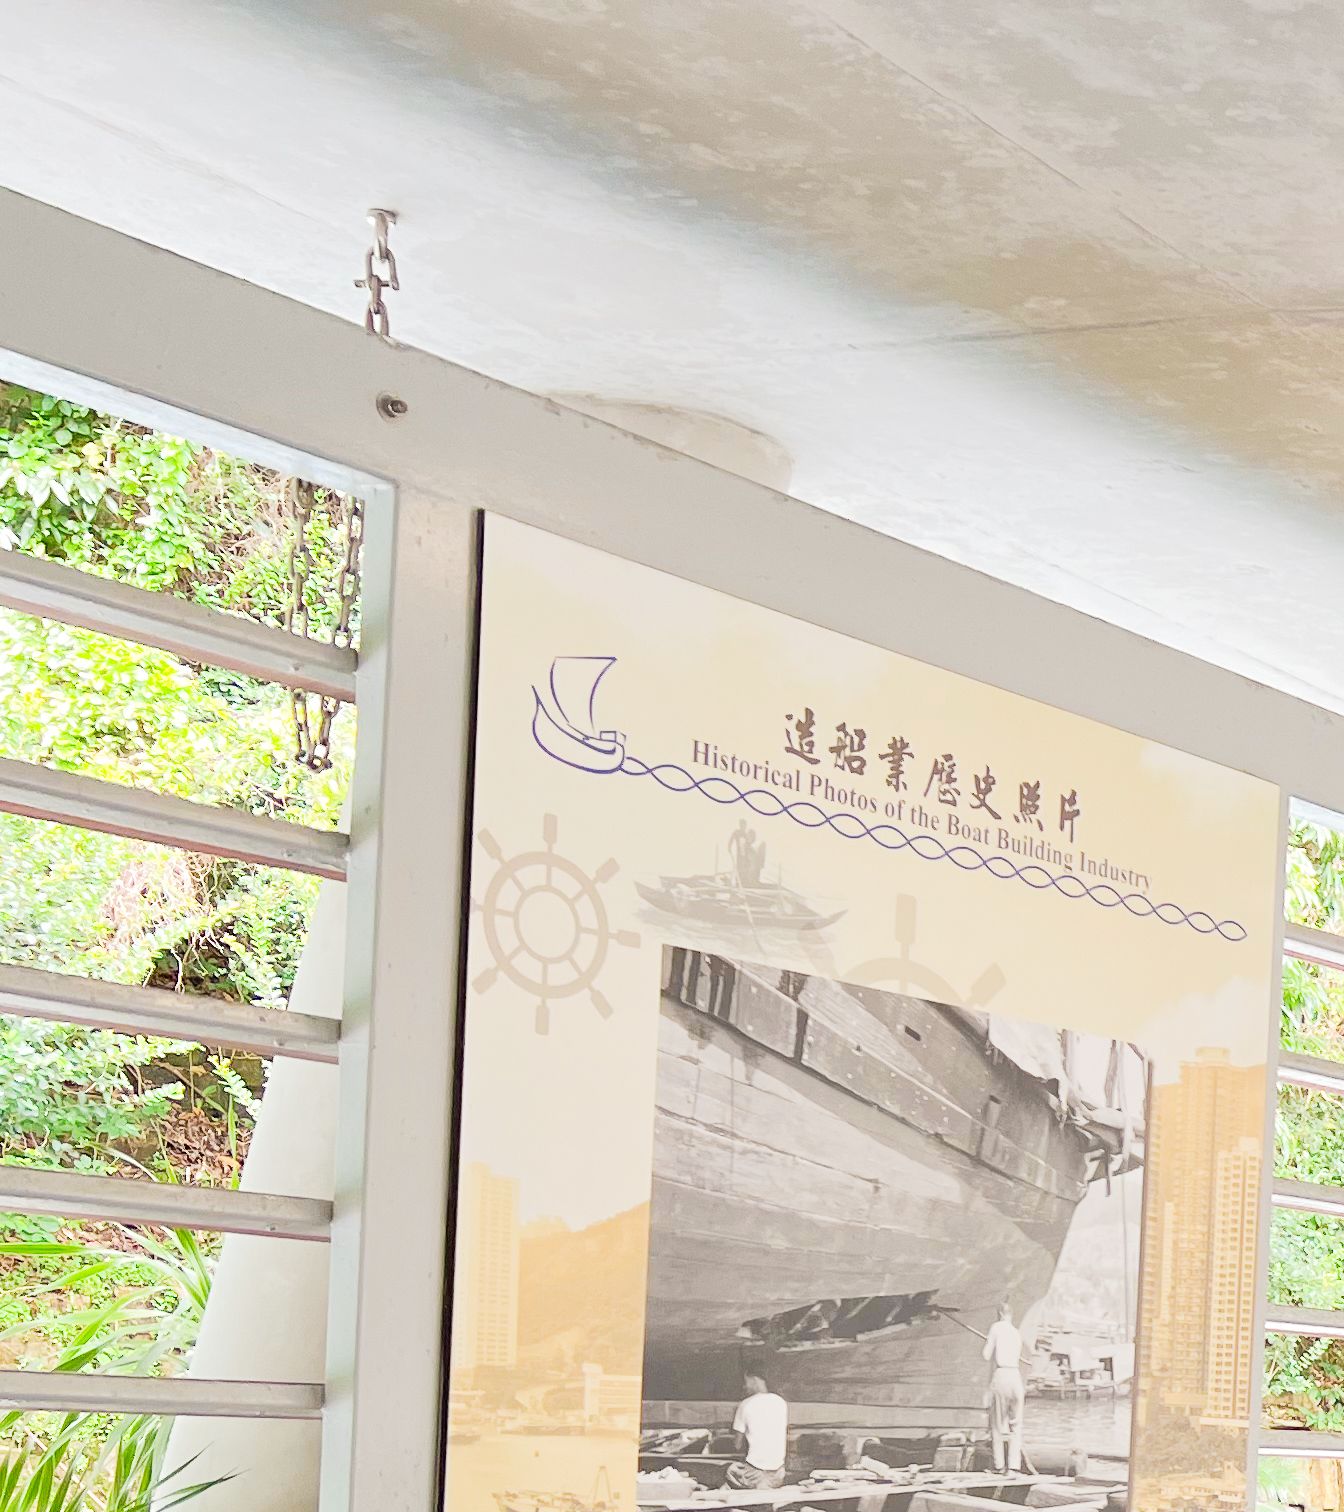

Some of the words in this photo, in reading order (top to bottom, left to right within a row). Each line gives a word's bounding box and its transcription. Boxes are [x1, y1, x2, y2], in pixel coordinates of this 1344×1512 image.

[692, 739, 800, 792] Historical
[809, 772, 877, 813] Photos
[884, 799, 906, 821] of
[911, 805, 940, 832] the
[946, 813, 990, 846] Boat
[996, 828, 1074, 872] Building
[1079, 851, 1153, 894] Industry
[785, 707, 1080, 843] 造船業歷史照片
